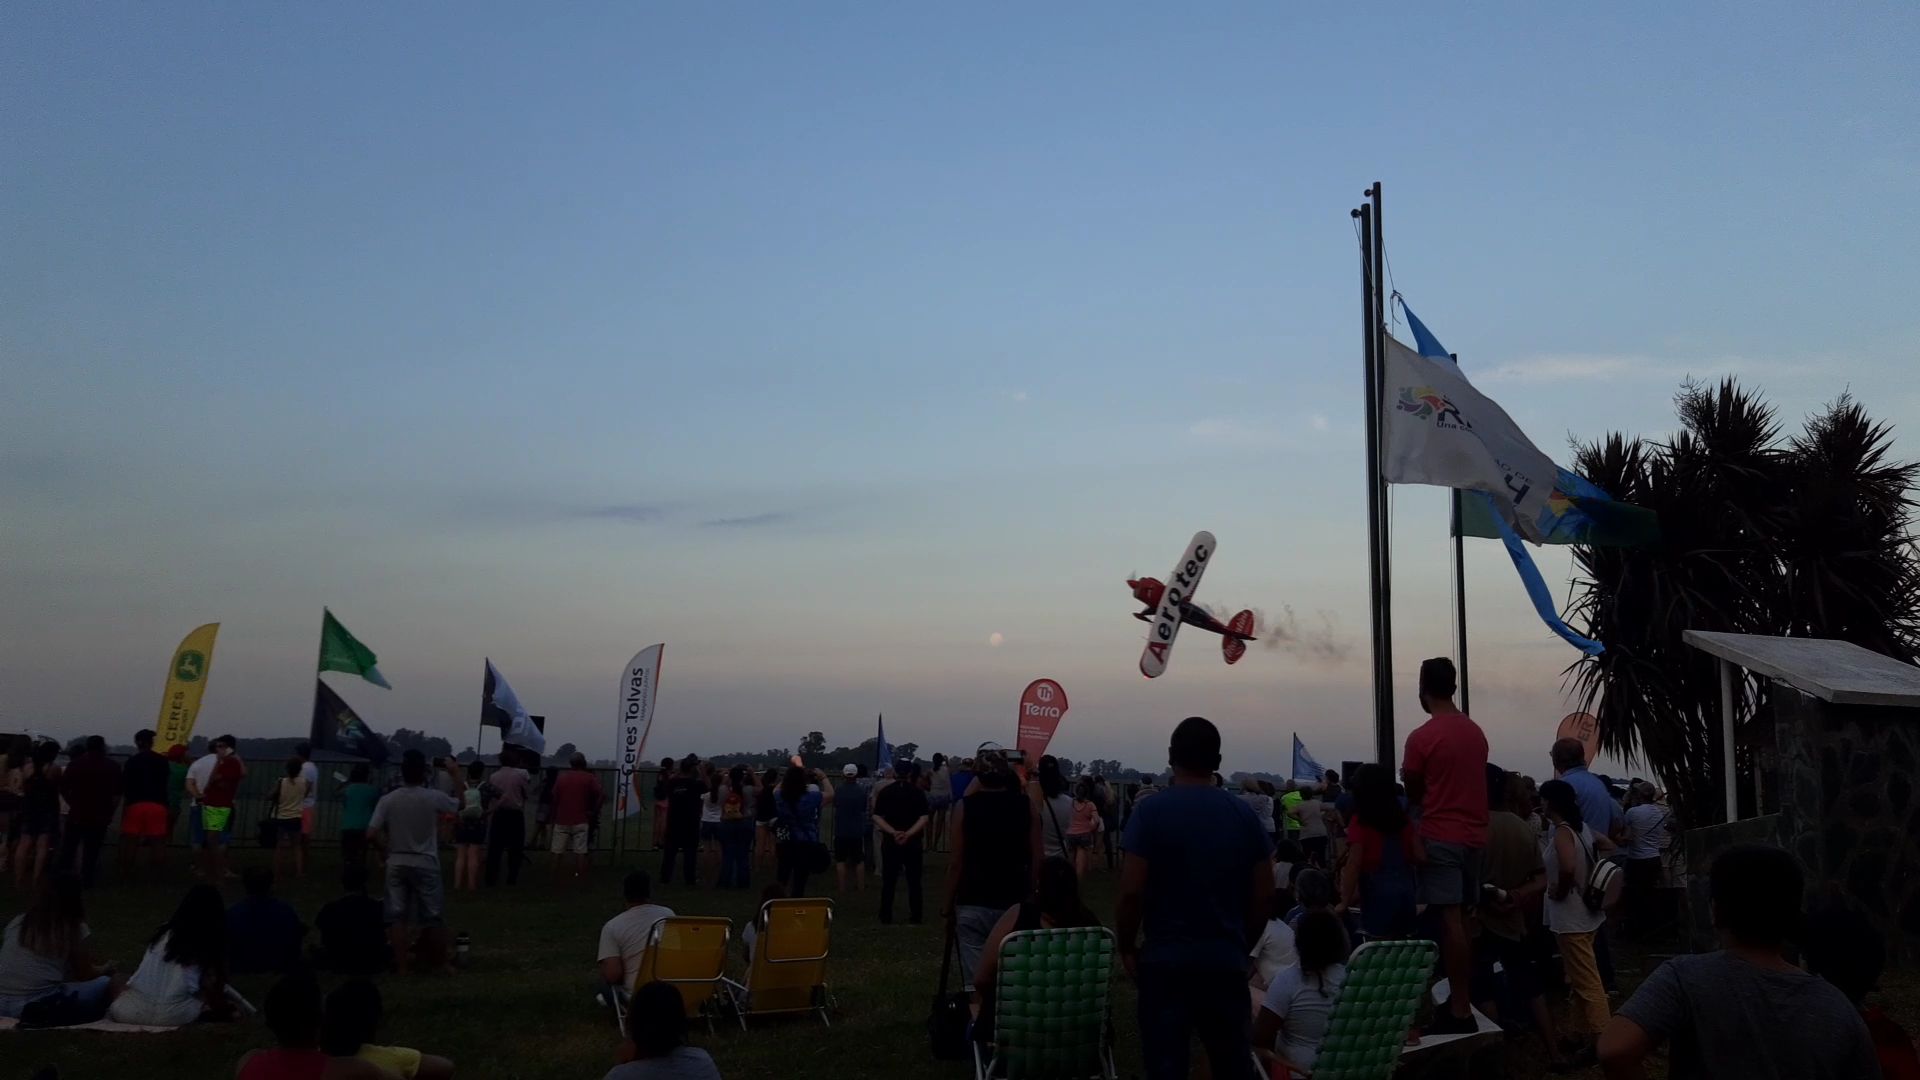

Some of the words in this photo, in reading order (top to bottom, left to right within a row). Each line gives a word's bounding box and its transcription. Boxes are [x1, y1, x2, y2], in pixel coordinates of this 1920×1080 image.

[1149, 544, 1209, 665] Aerotec
[165, 691, 185, 741] CERES
[624, 667, 644, 723] Tolvas
[1023, 702, 1060, 718] Terra
[1039, 686, 1053, 699] Th
[621, 726, 638, 777] Ceres
